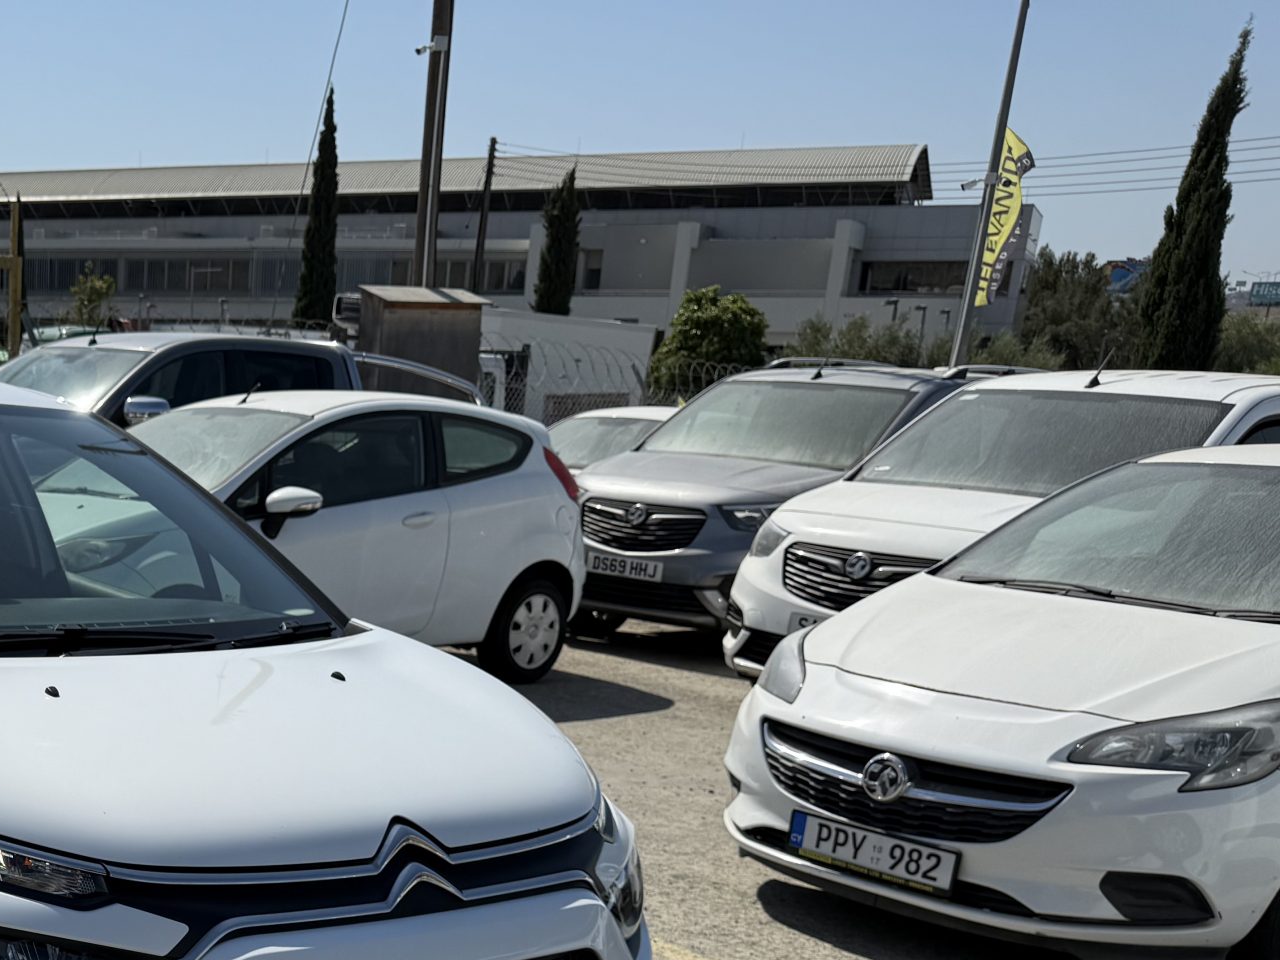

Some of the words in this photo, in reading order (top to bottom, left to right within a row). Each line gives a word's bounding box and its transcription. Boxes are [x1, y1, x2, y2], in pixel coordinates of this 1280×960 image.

[592, 555, 626, 574] DS69
[629, 560, 657, 579] HHJ
[815, 823, 866, 860] PPY
[888, 844, 941, 882] 982
